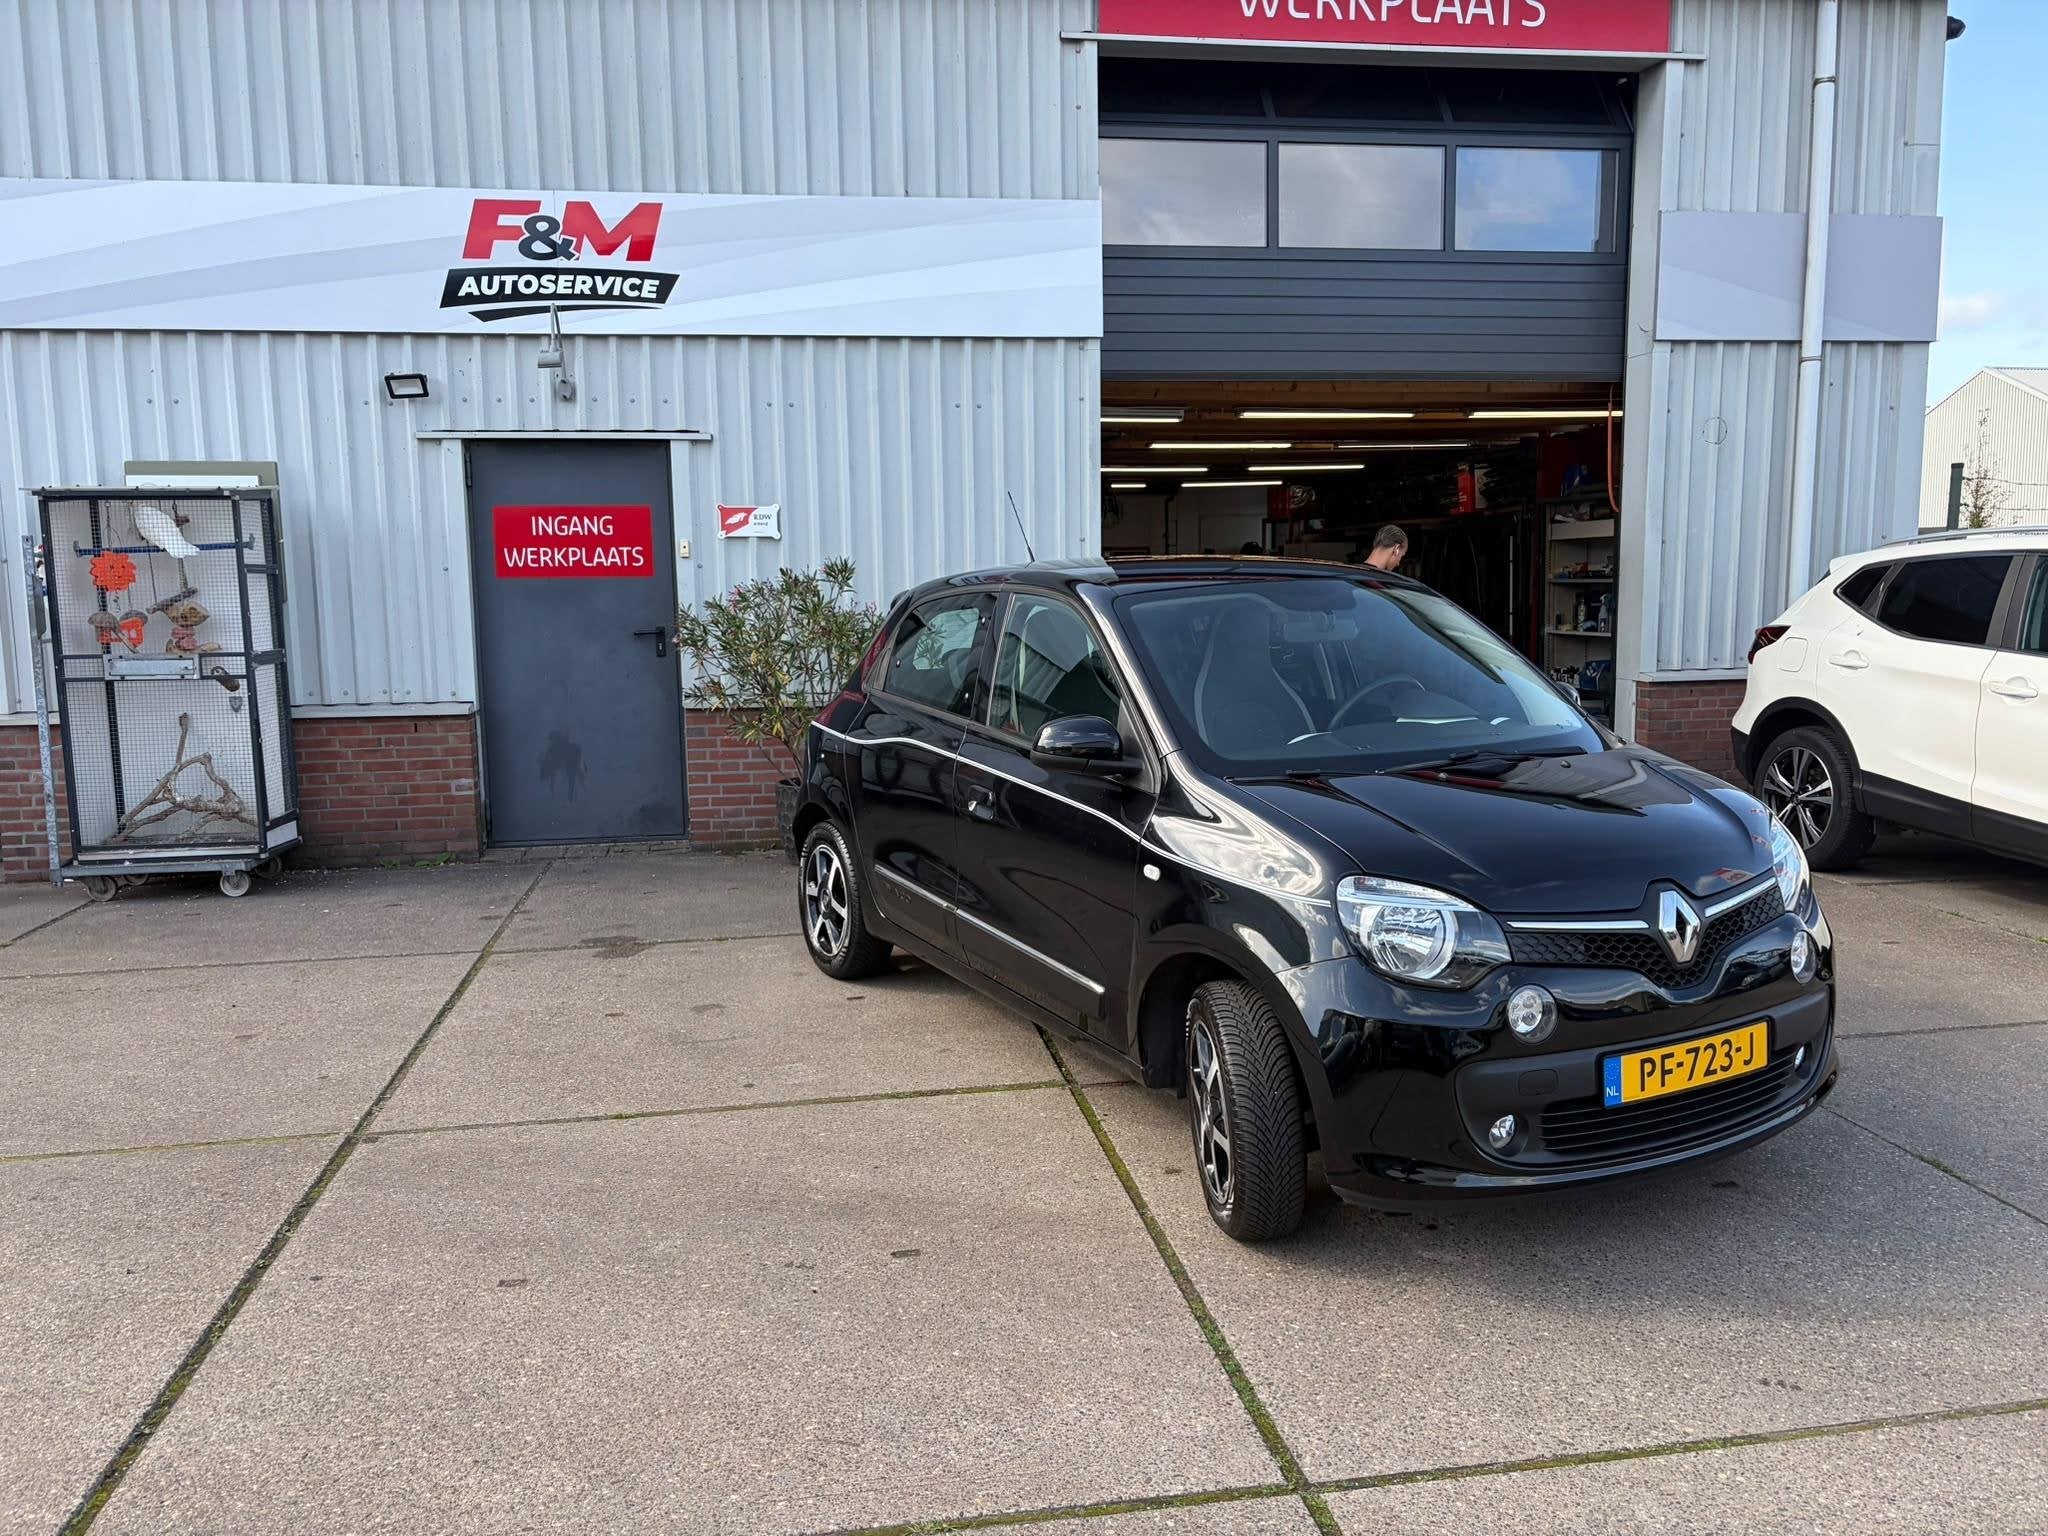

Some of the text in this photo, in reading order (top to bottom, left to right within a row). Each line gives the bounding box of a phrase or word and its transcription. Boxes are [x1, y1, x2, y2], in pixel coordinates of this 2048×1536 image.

[462, 198, 664, 262] F&M
[458, 274, 660, 299] AUTOSERVICE
[531, 515, 613, 536] INGANG
[503, 546, 644, 567] WERKPLAATS
[1640, 1032, 1754, 1092] PF-723-J
[1606, 1087, 1619, 1097] NL
